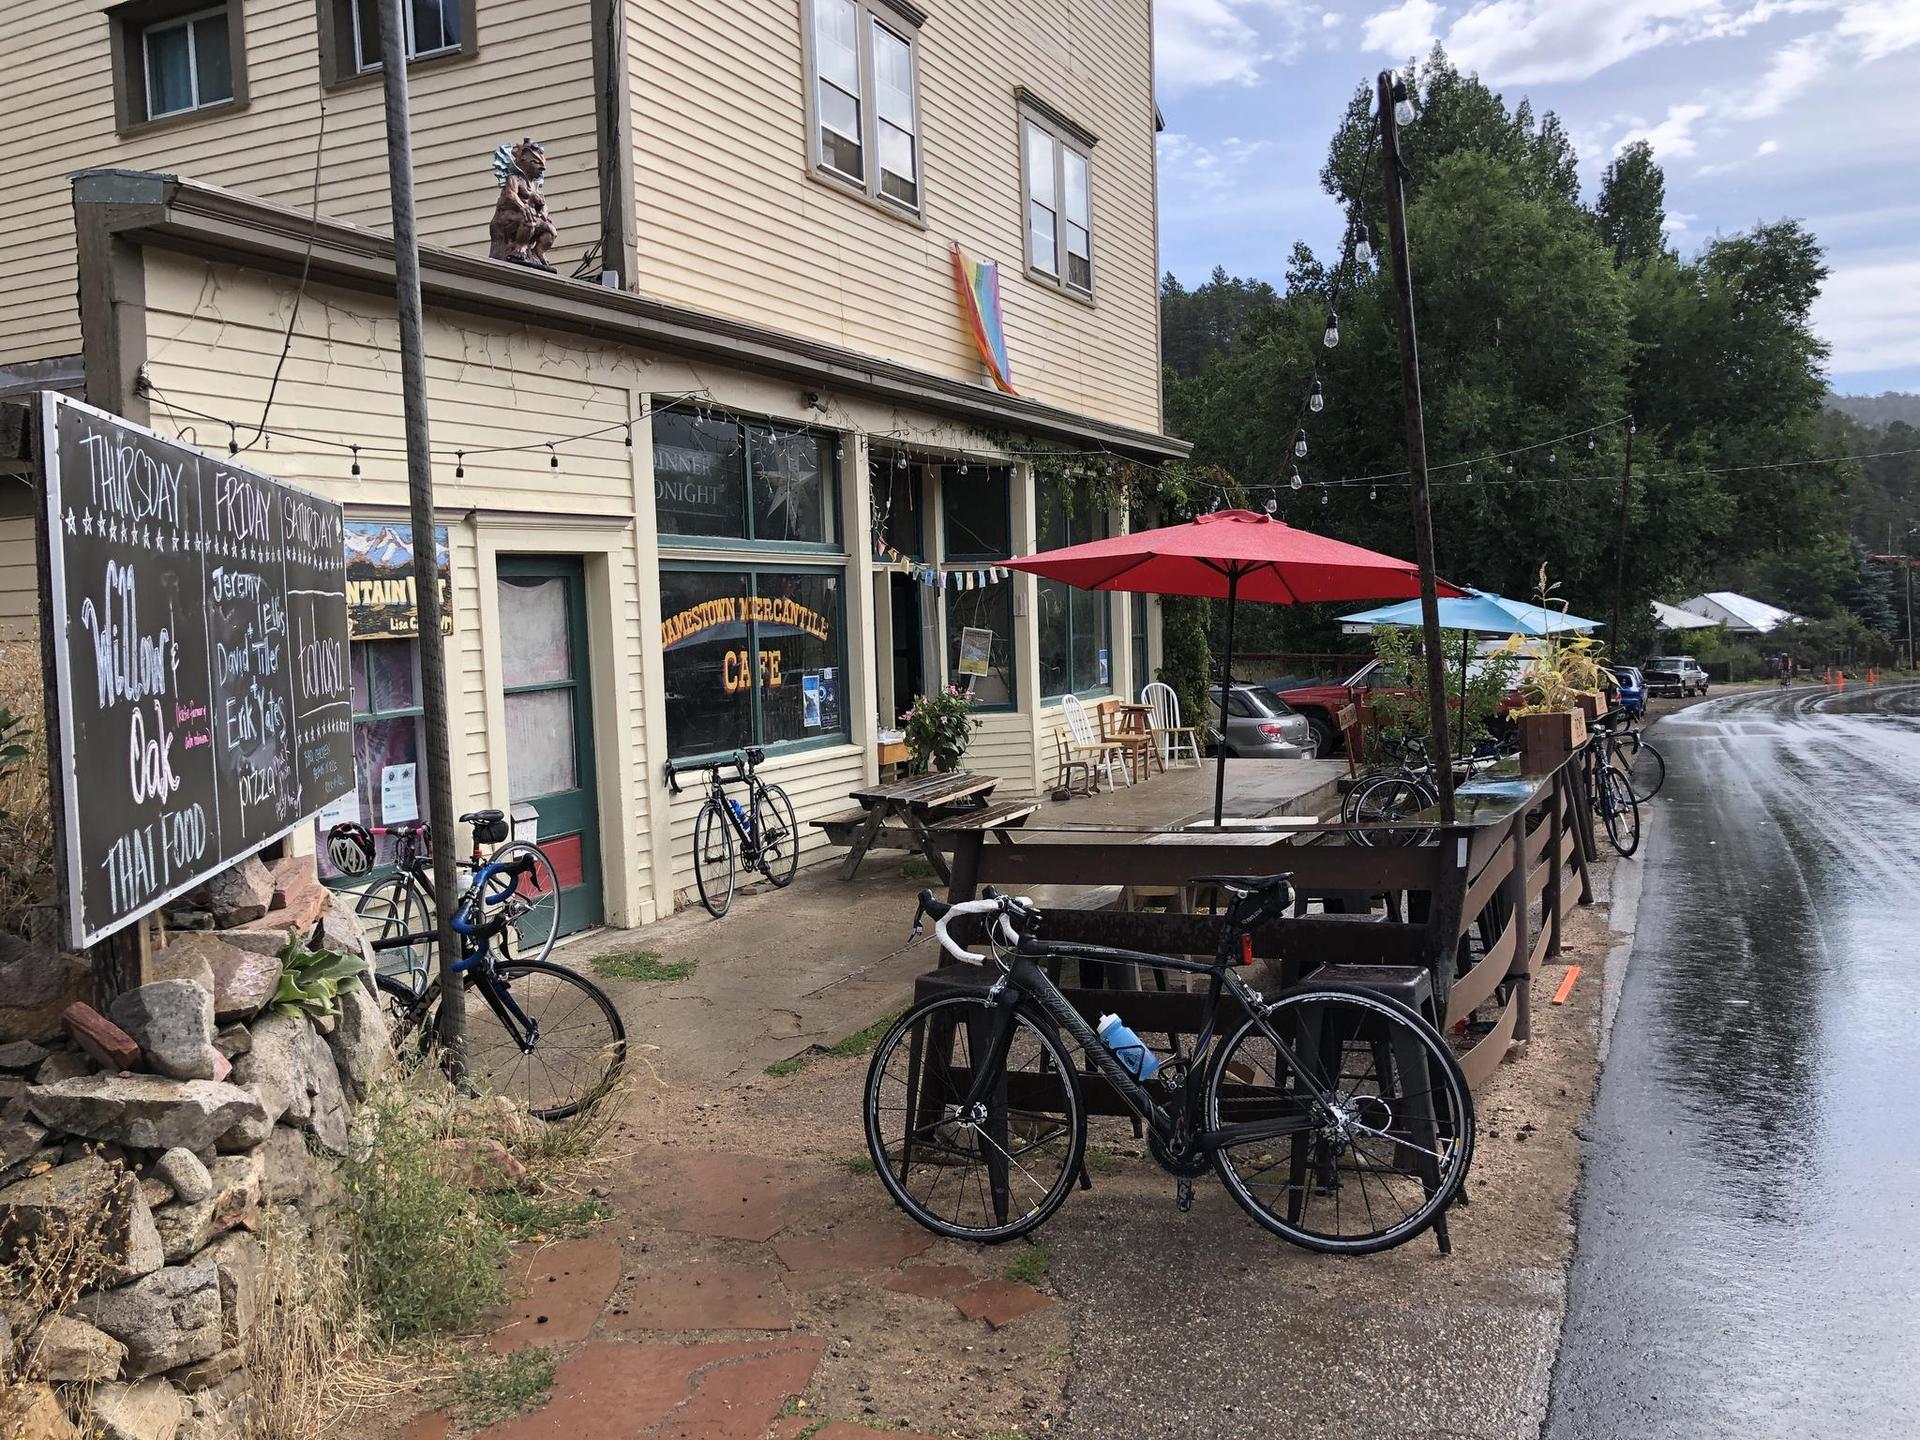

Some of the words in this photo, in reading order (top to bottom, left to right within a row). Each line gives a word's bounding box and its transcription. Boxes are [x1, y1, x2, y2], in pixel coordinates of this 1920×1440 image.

[79, 426, 183, 529] THURSDAY
[654, 449, 712, 477] INNER
[655, 478, 718, 504] ONIGHT
[216, 472, 270, 541] FRIDAY
[285, 496, 333, 550] SATURDAY
[212, 566, 261, 624] Jeremy
[346, 579, 407, 606] NTAIN
[81, 560, 169, 709] Willow
[390, 617, 408, 630] Lisa
[660, 597, 735, 648] JAMESTOWN
[739, 596, 830, 641] MERCANTILE
[217, 634, 249, 687] David
[723, 650, 782, 692] CAFE
[226, 695, 257, 752] Erik
[257, 686, 287, 746] Yates
[131, 699, 180, 805] Oak
[239, 764, 276, 838] pizza
[102, 824, 158, 915] THAI
[159, 803, 206, 886] FOOD
